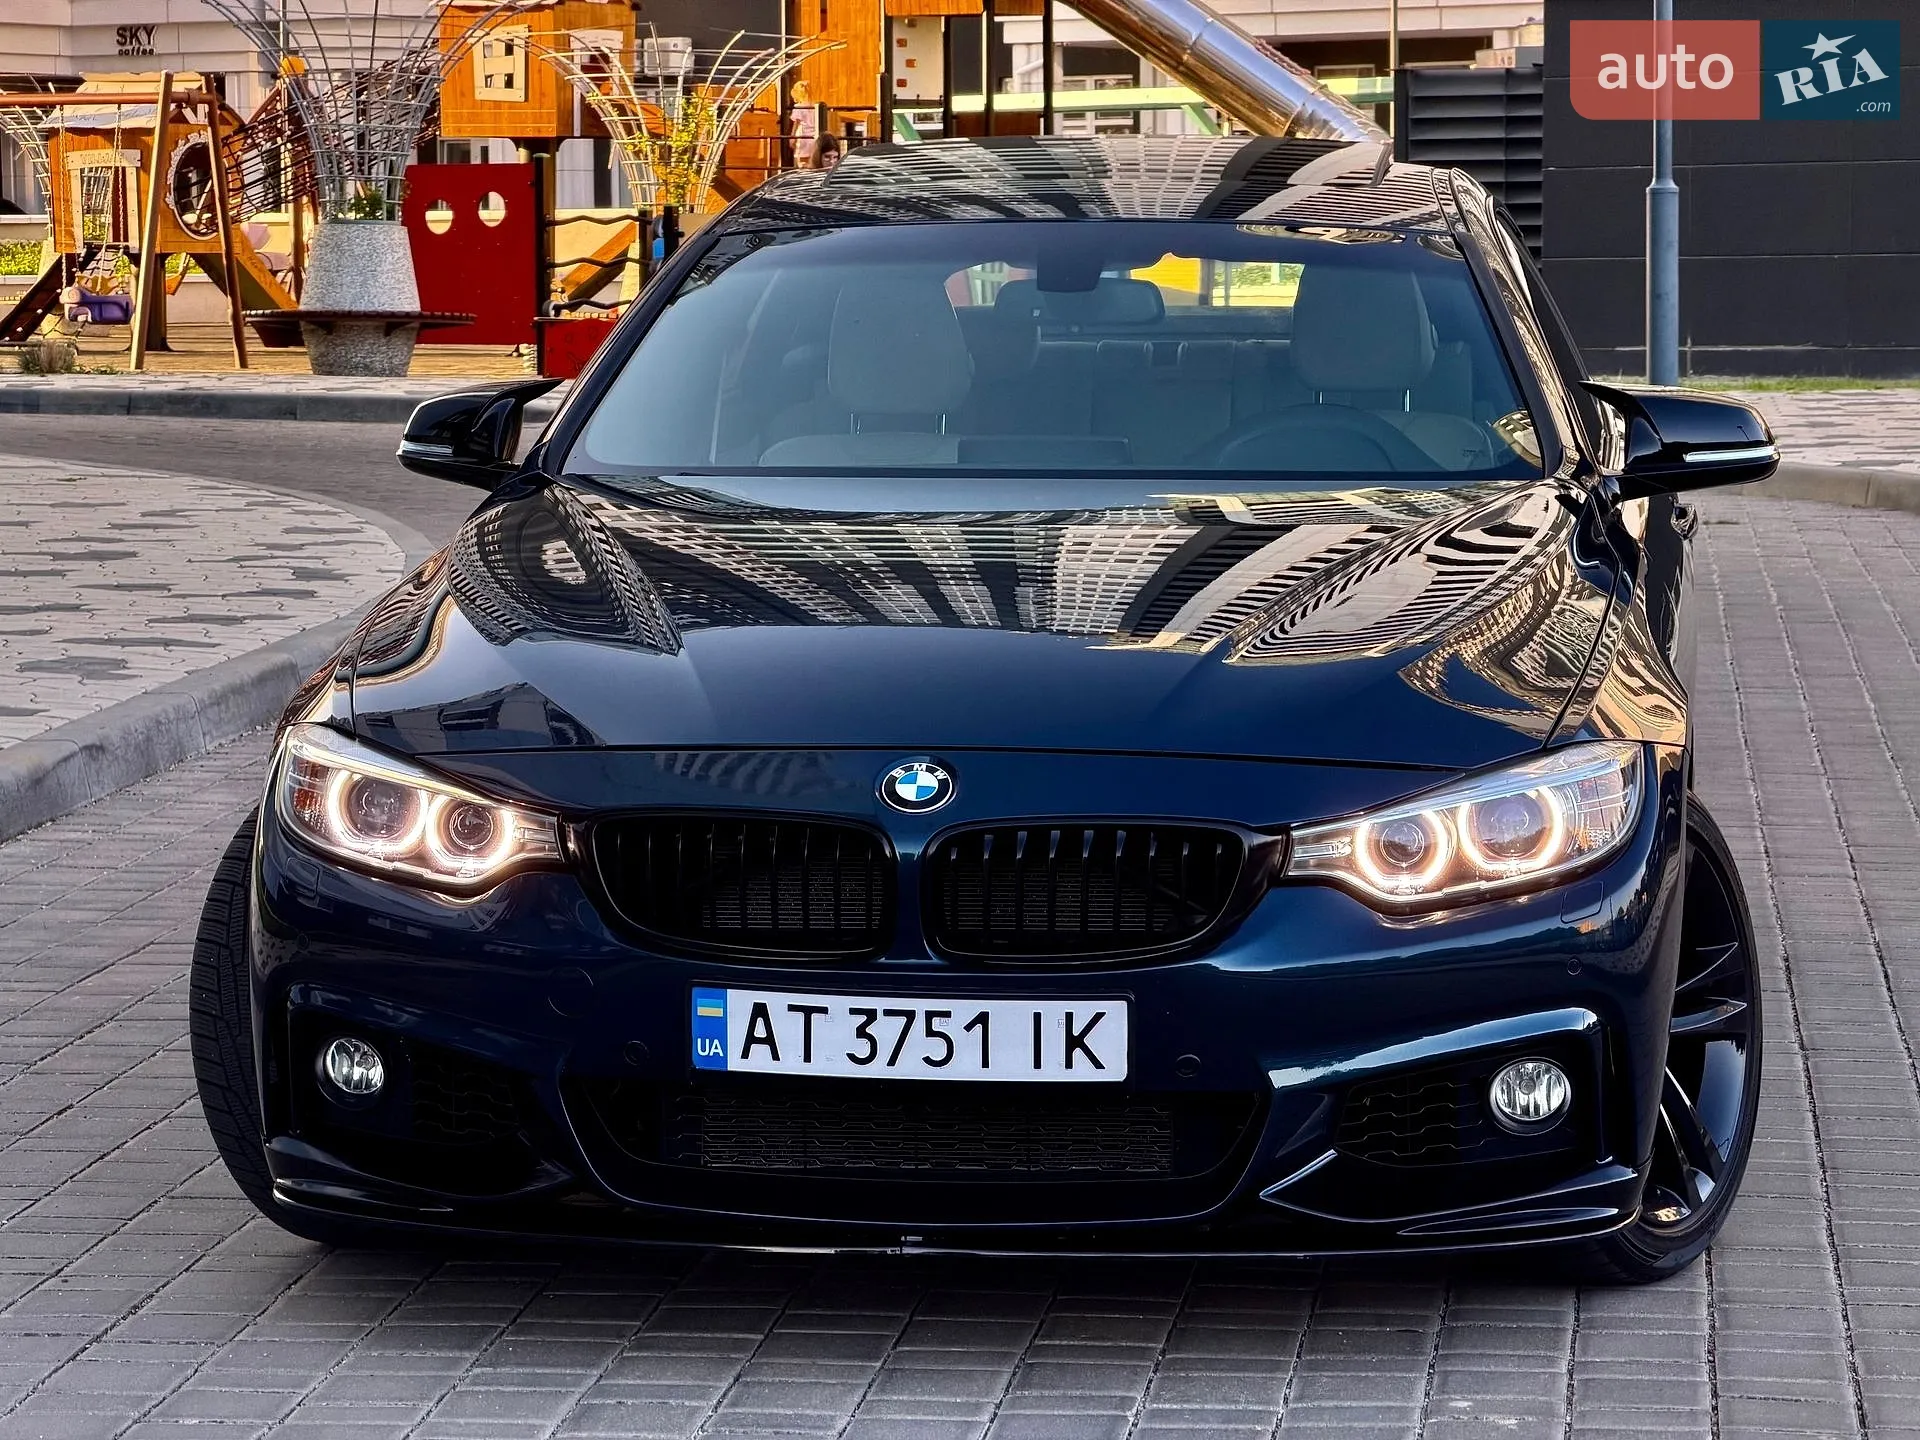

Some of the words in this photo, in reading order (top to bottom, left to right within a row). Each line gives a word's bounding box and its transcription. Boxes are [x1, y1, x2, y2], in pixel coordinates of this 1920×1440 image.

[116, 25, 155, 46] SKY
[891, 763, 947, 780] BMW
[740, 1001, 829, 1063] AT
[845, 1007, 990, 1068] 3751
[1033, 1011, 1107, 1070] IK
[697, 1038, 724, 1057] UA
